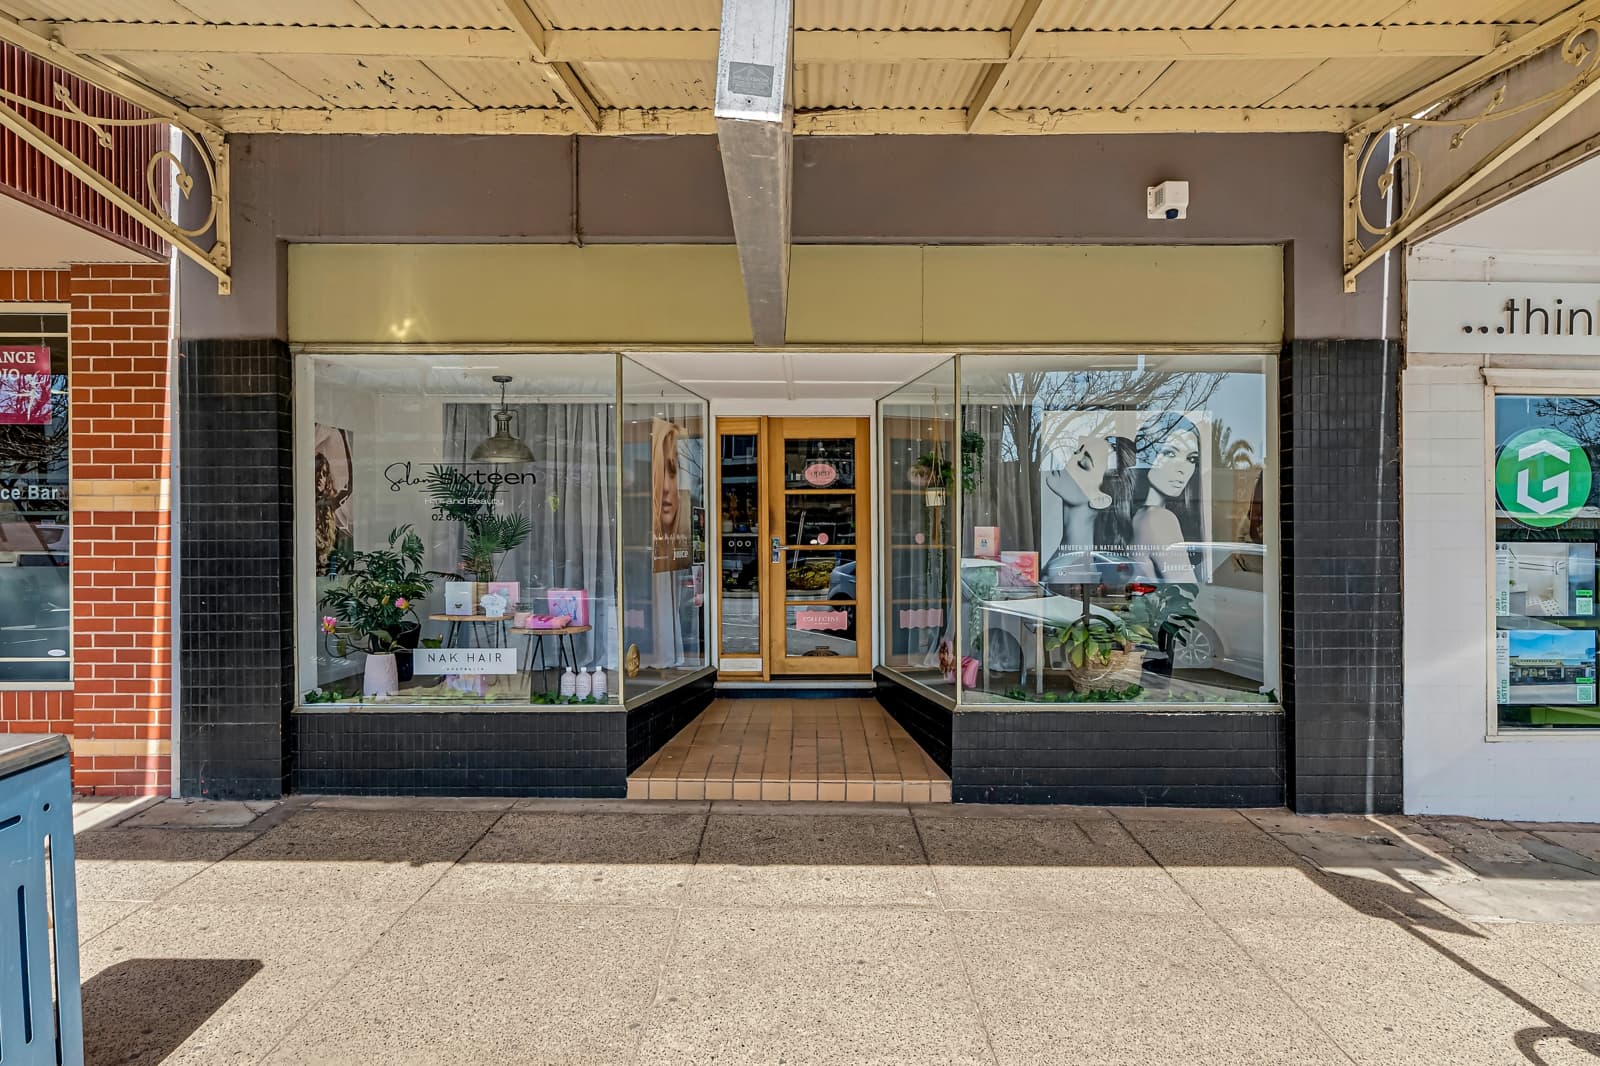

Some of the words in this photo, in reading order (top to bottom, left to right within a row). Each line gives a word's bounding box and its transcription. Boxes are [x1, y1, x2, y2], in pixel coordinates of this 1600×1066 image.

[0, 368, 20, 381] IO
[440, 468, 536, 485] sixteen
[0, 488, 21, 500] ce
[28, 485, 58, 500] Bar
[447, 497, 466, 505] and
[467, 497, 504, 506] Beauty
[431, 513, 444, 521] 02
[427, 652, 458, 663] NAK
[467, 652, 503, 663] HAIR
